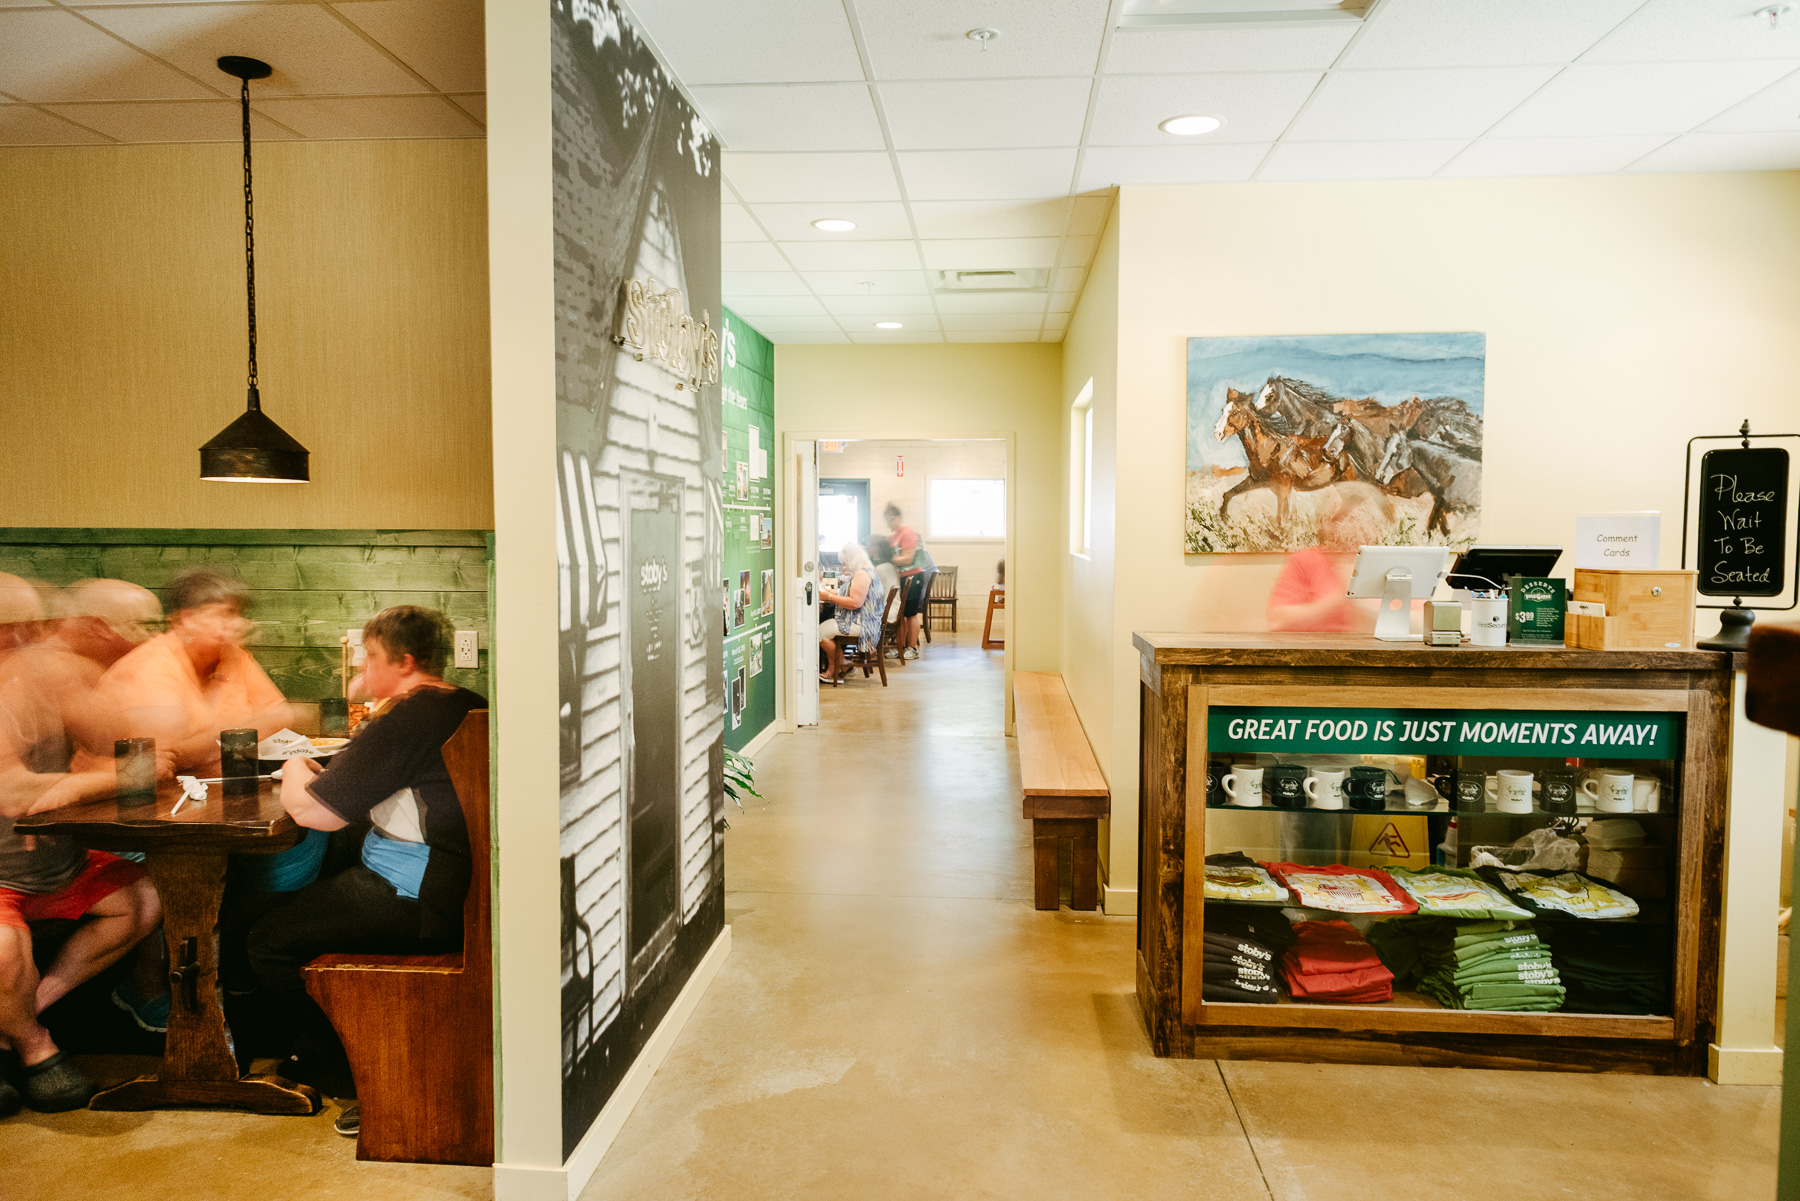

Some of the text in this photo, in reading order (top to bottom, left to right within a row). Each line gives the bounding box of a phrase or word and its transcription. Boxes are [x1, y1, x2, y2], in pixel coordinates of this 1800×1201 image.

[1710, 474, 1775, 502] Please
[1717, 509, 1762, 530] Wait
[1596, 534, 1638, 543] Comment
[1714, 536, 1764, 554] To Be
[1603, 548, 1630, 557] Cards
[640, 556, 668, 591] stoby's
[1710, 560, 1770, 583] Seated
[1520, 581, 1556, 594] DESSERTS
[1228, 719, 1658, 745] GREAT FOOD IS JUST MOMENTS AWAY!
[1237, 944, 1272, 961] stoby's
[1518, 969, 1554, 981] stoby's
